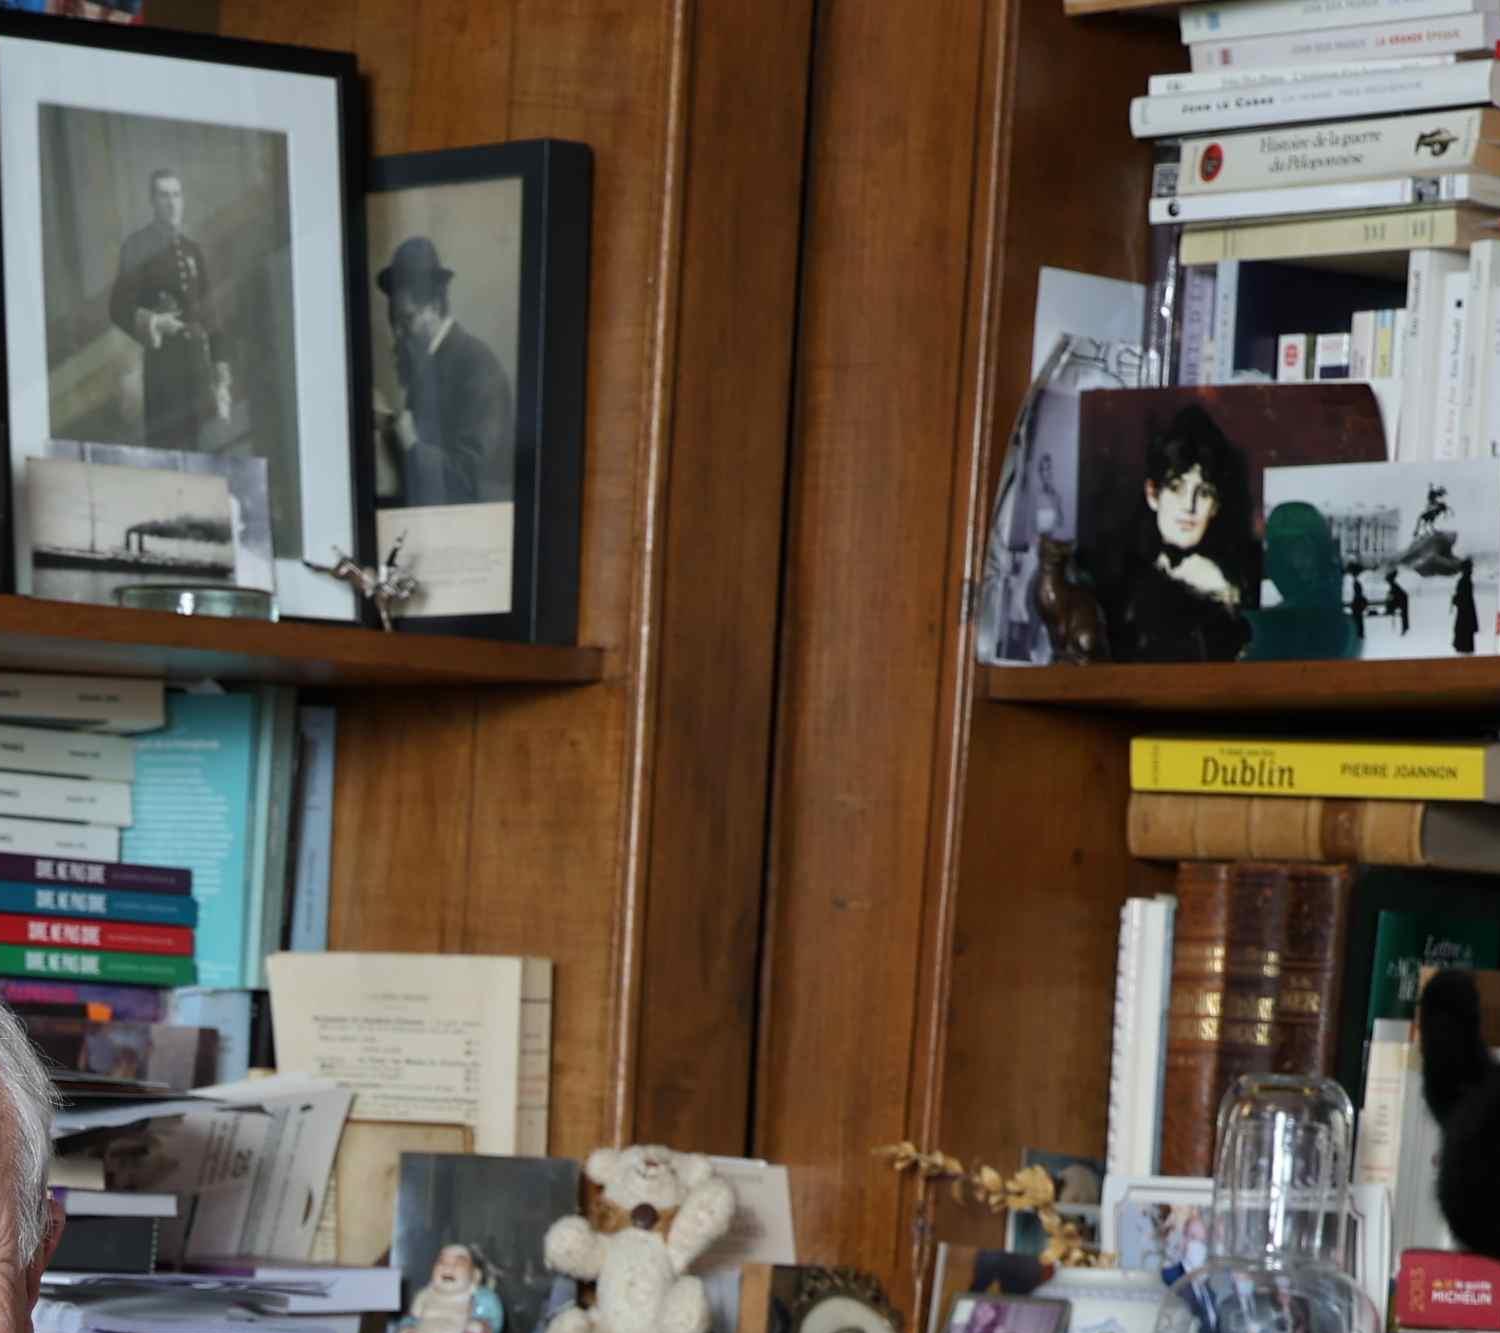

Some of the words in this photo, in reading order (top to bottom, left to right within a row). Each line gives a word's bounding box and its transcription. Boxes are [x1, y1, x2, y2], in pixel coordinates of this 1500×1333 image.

[1199, 756, 1296, 789] Dublin
[1339, 761, 1388, 779] PIERRE
[1430, 1289, 1493, 1306] MICHELIN
